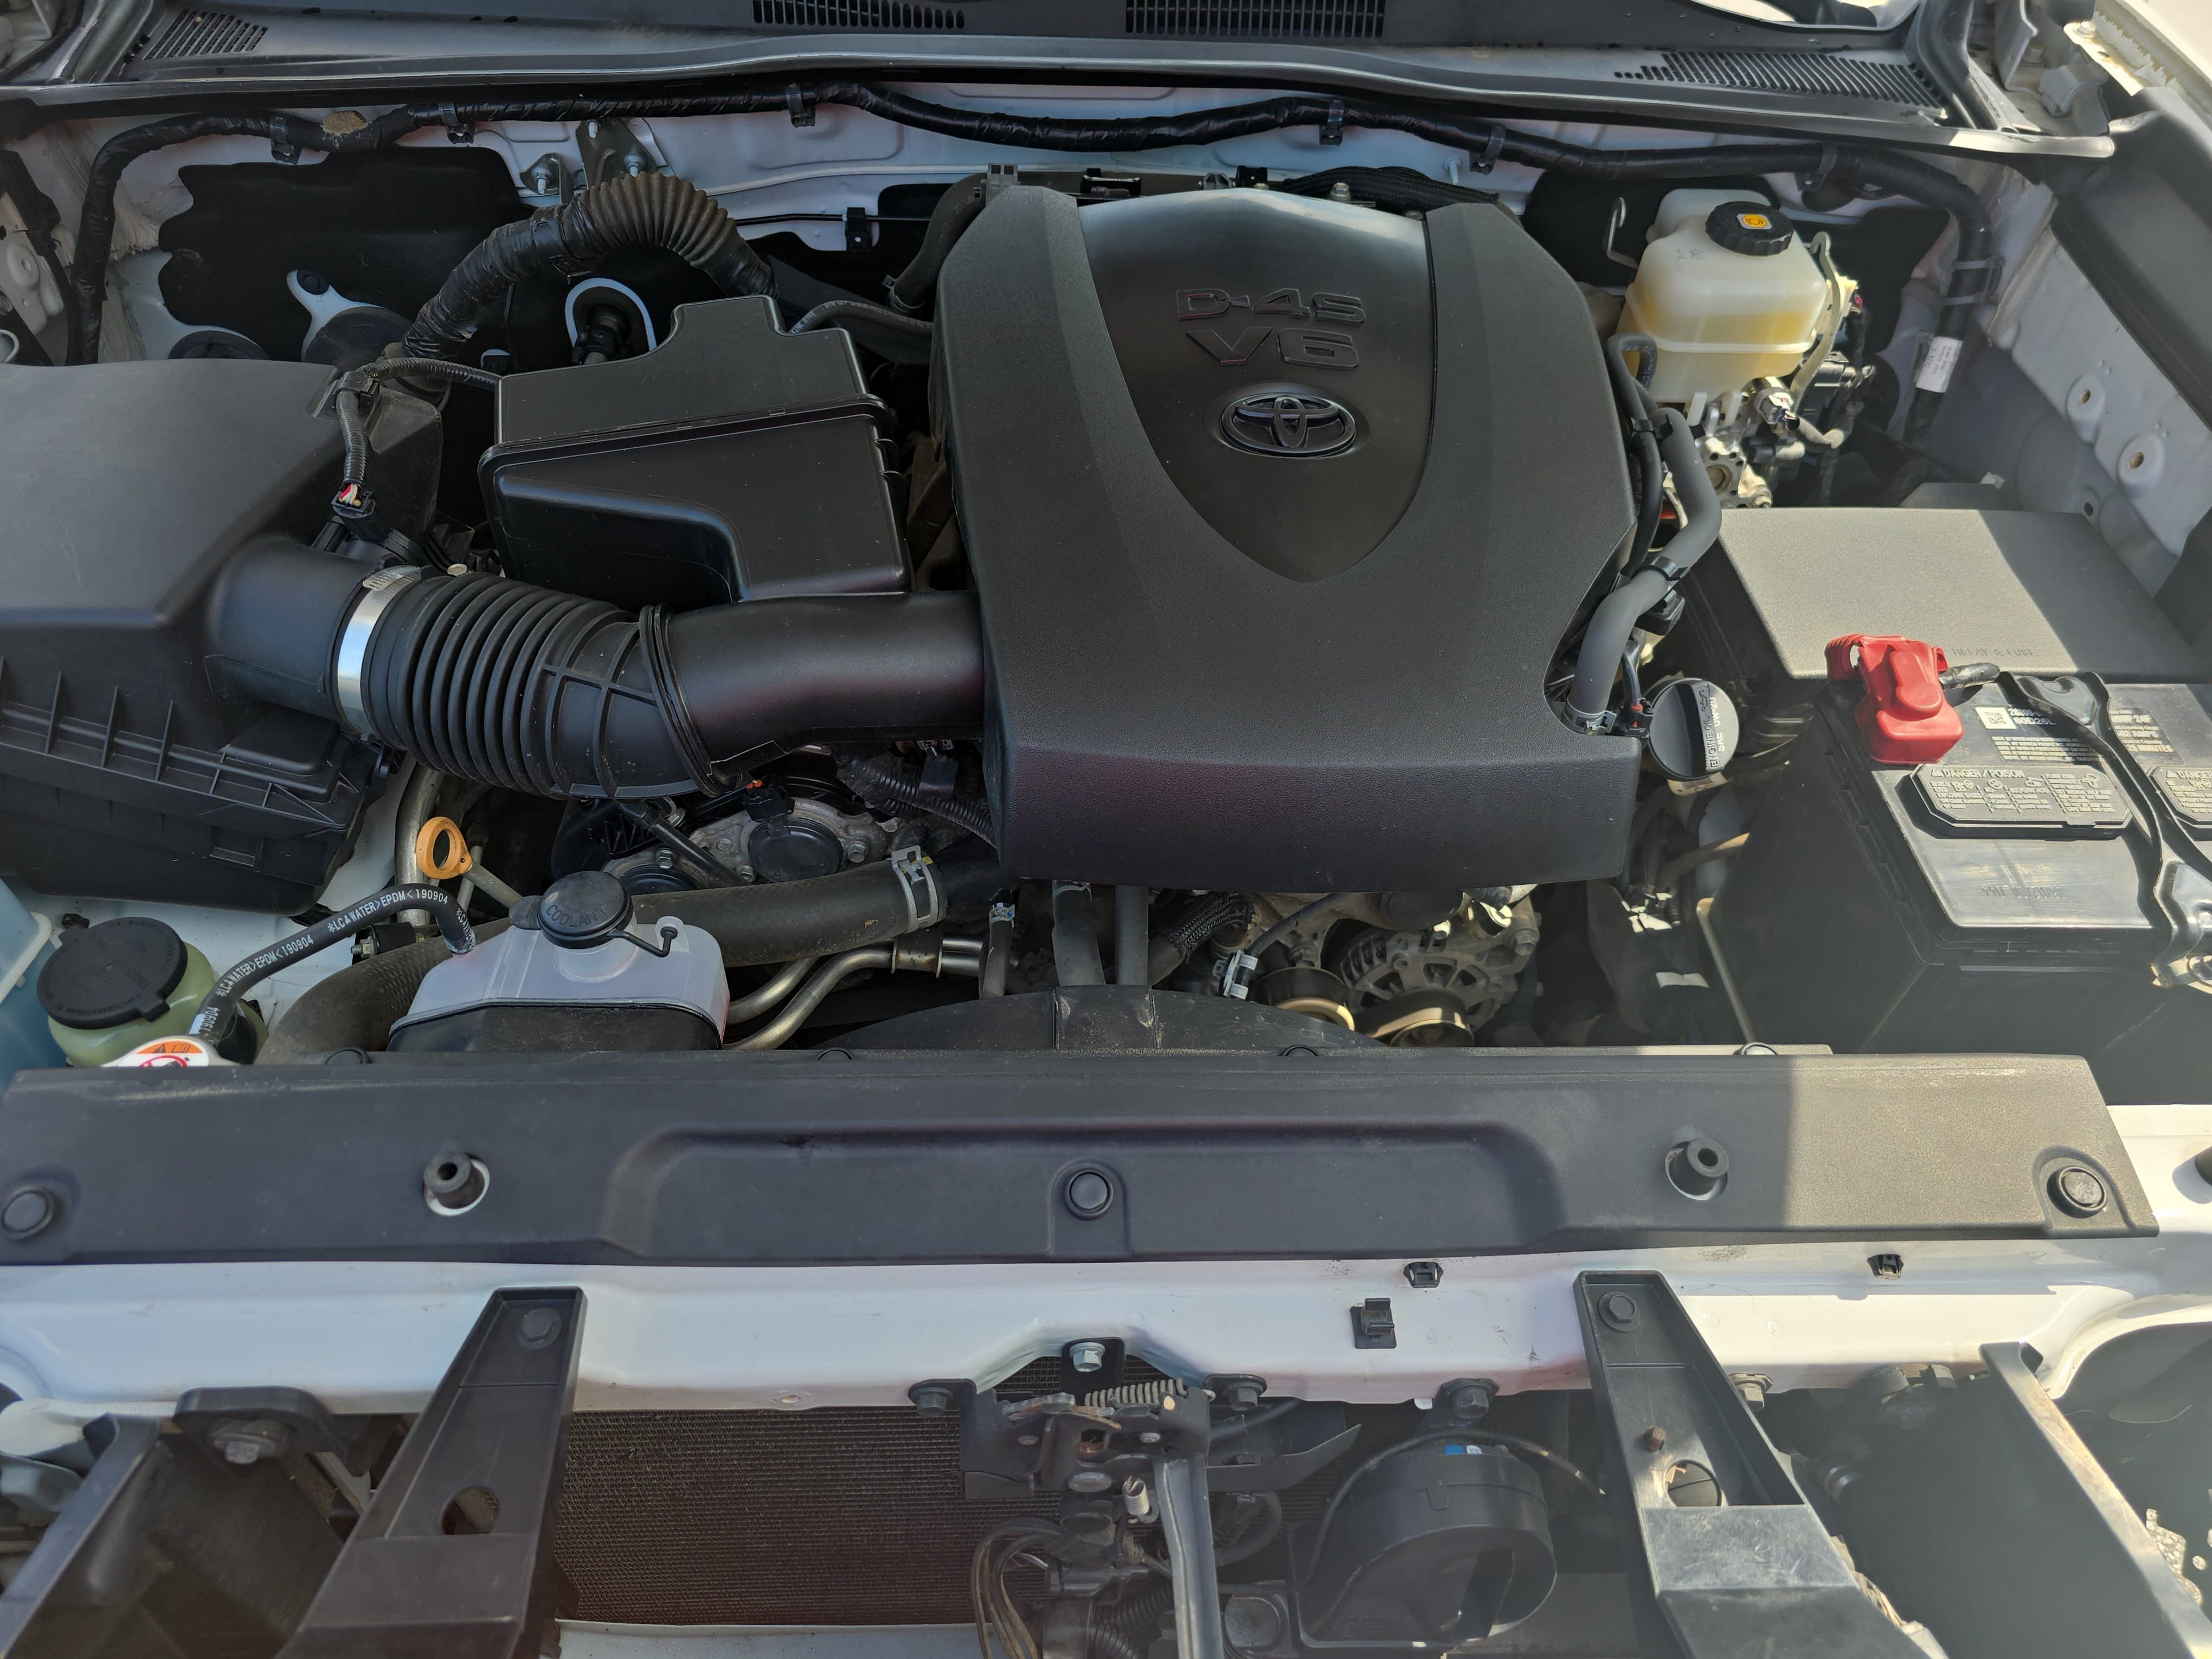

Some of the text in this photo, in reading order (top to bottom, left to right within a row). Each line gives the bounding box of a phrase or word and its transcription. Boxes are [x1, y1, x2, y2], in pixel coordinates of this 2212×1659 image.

[1176, 288, 1366, 325] D-4S
[1185, 326, 1359, 371] V6
[1703, 715, 1719, 768] ENGINE OIL
[546, 904, 607, 928] COOLANT
